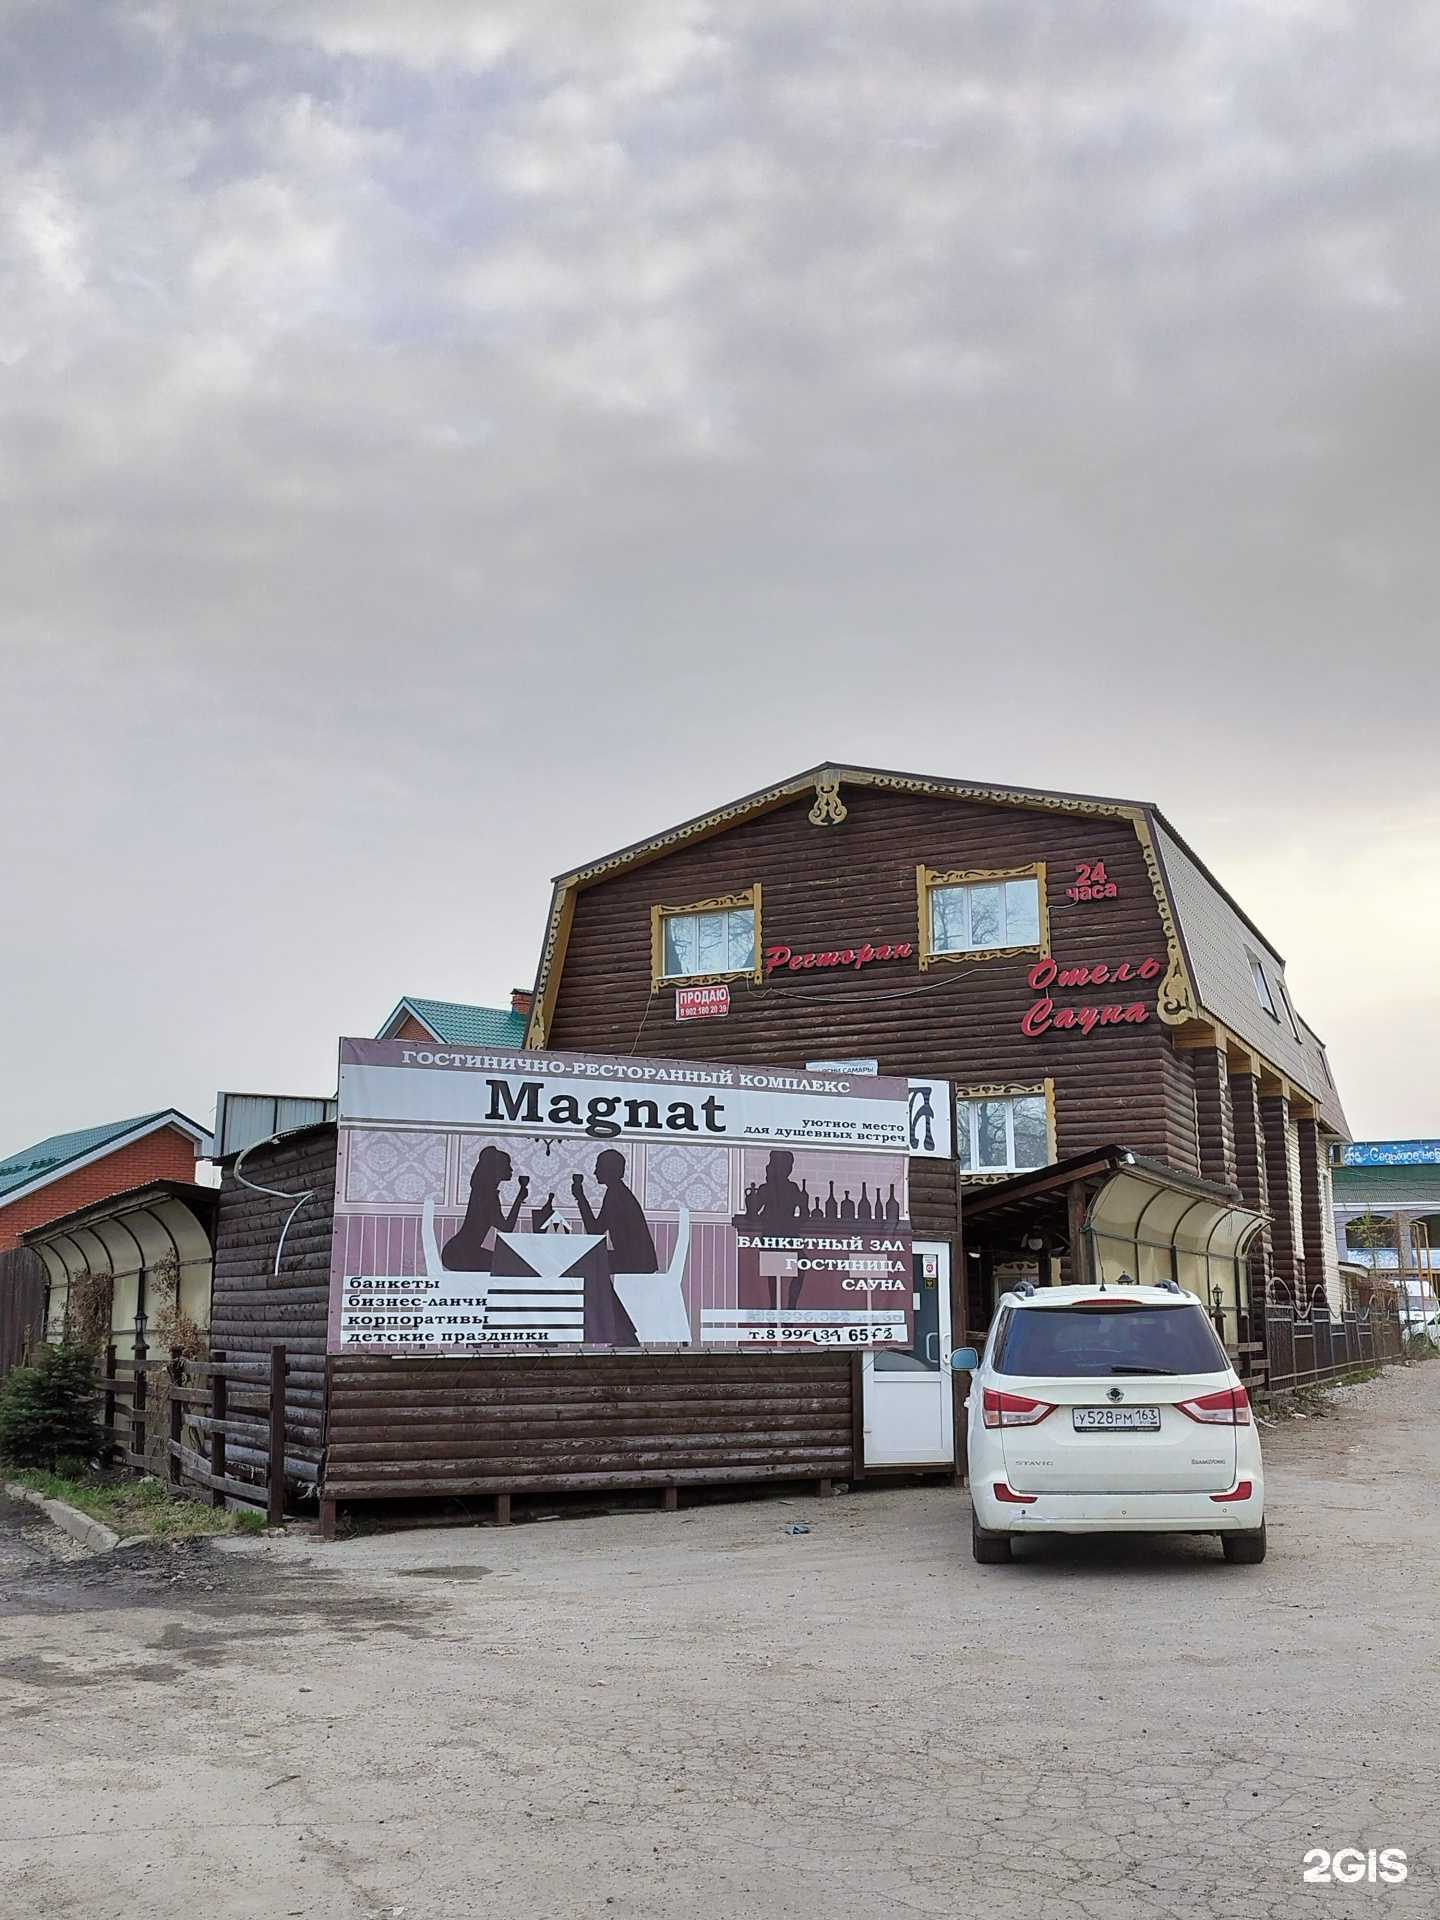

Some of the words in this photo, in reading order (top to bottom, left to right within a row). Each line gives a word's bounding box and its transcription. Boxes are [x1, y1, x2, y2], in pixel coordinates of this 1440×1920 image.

[1075, 862, 1108, 886] 24
[1066, 882, 1118, 900] часа
[765, 942, 913, 975] Ресторан
[1027, 957, 1161, 990] Отель
[680, 988, 727, 1005] ПРОДАЮ
[1021, 998, 1151, 1037] Сауна
[401, 1050, 734, 1085] ГОСТИНИЧНО-РЕСТОРАННЫЙ
[739, 1073, 851, 1094] КОМПЛЕКС
[484, 1079, 727, 1139] Magnat
[801, 1118, 858, 1130] уютное
[862, 1122, 905, 1132] место
[743, 1126, 770, 1135] для
[774, 1128, 853, 1139] душевных
[856, 1133, 906, 1144] встреч
[736, 1236, 864, 1251] БАНКЕТНЫЙ
[869, 1239, 905, 1251] ЗАЛ
[784, 1258, 906, 1273] ГОСТИНИЦА
[349, 1276, 441, 1290] банкеты
[841, 1279, 906, 1291] САУНА
[348, 1295, 488, 1308] бизнес-ланчи
[347, 1314, 490, 1328] корпоративы
[347, 1331, 435, 1344] детские
[440, 1330, 550, 1344] праздники
[849, 1328, 869, 1342] 65
